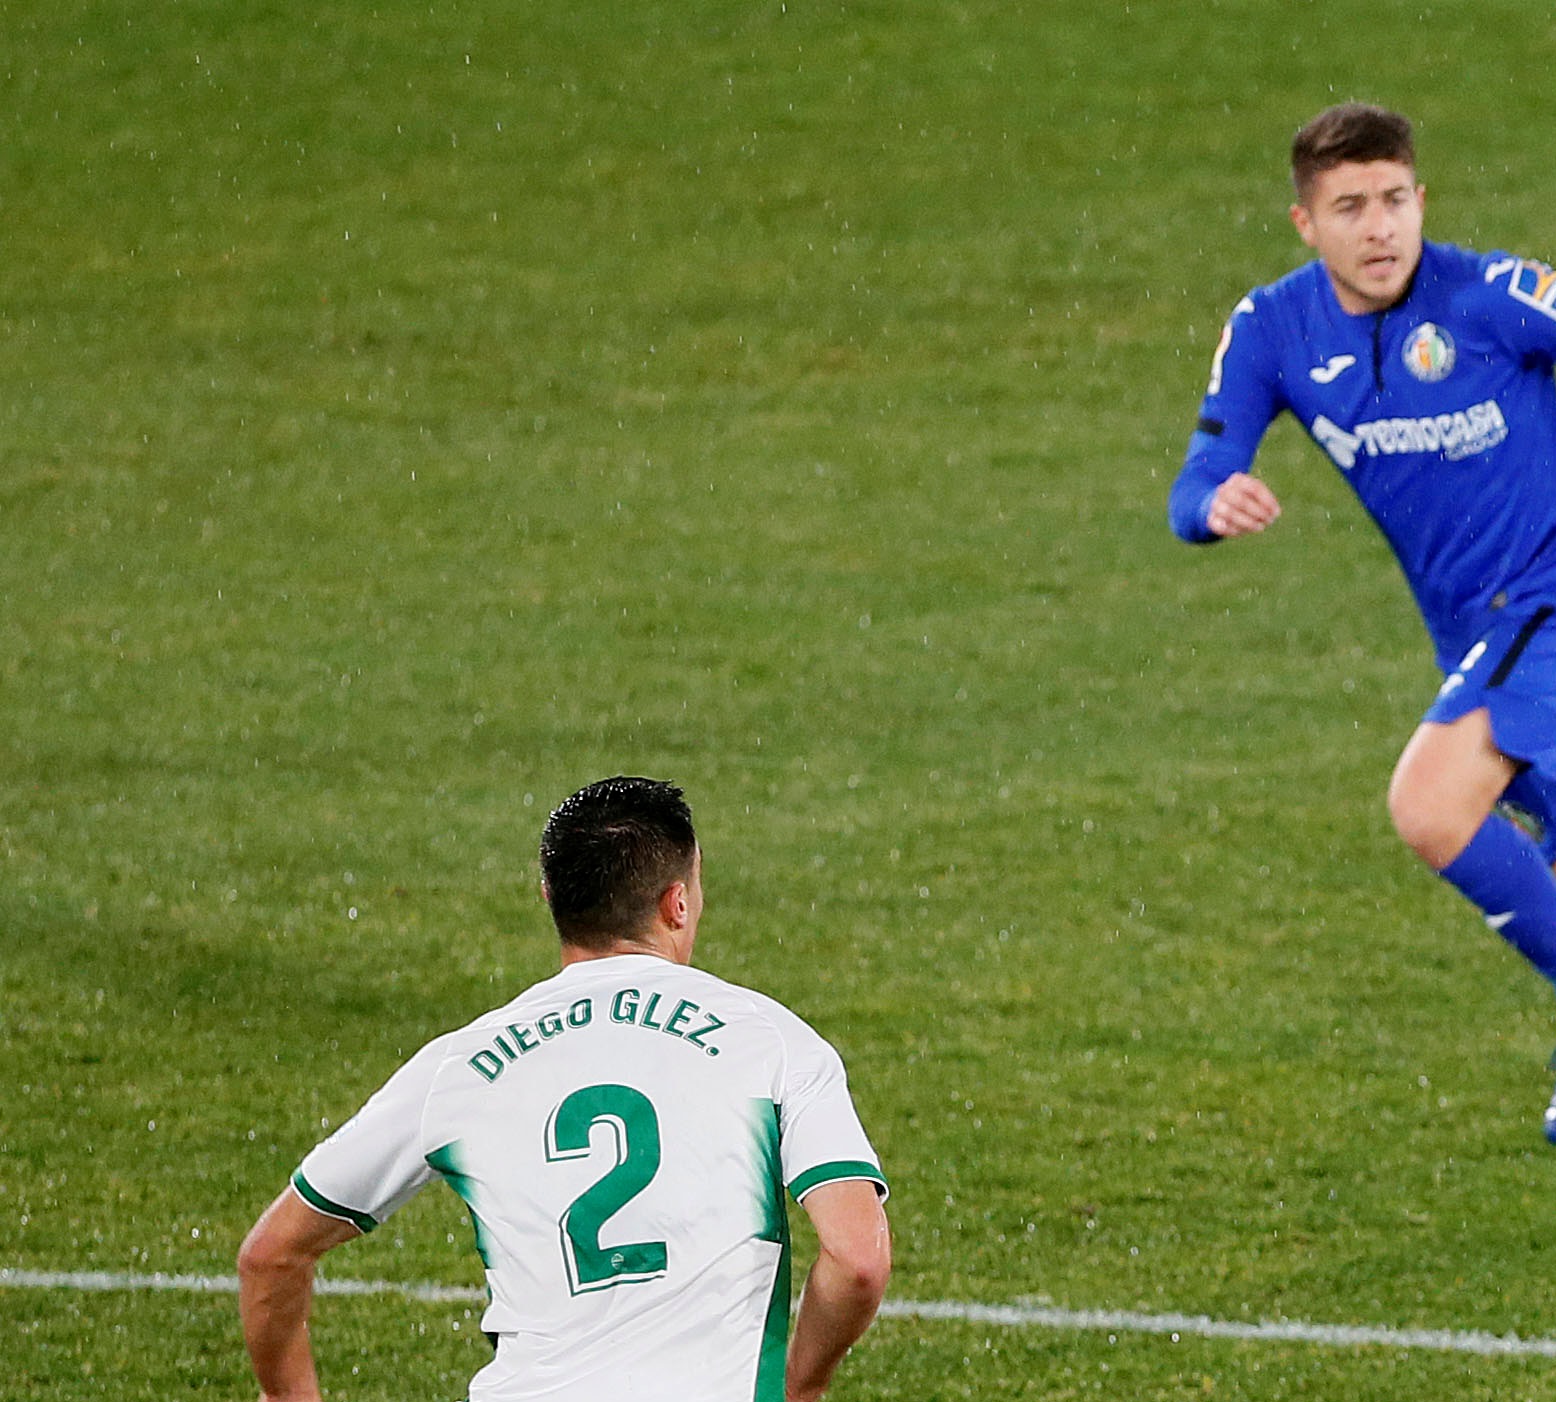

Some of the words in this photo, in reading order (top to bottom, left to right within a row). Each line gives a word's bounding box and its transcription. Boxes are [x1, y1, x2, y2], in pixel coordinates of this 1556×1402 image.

[467, 997, 593, 1083] DIEGO
[609, 988, 727, 1057] GLEZ.
[543, 1083, 669, 1297] 2
